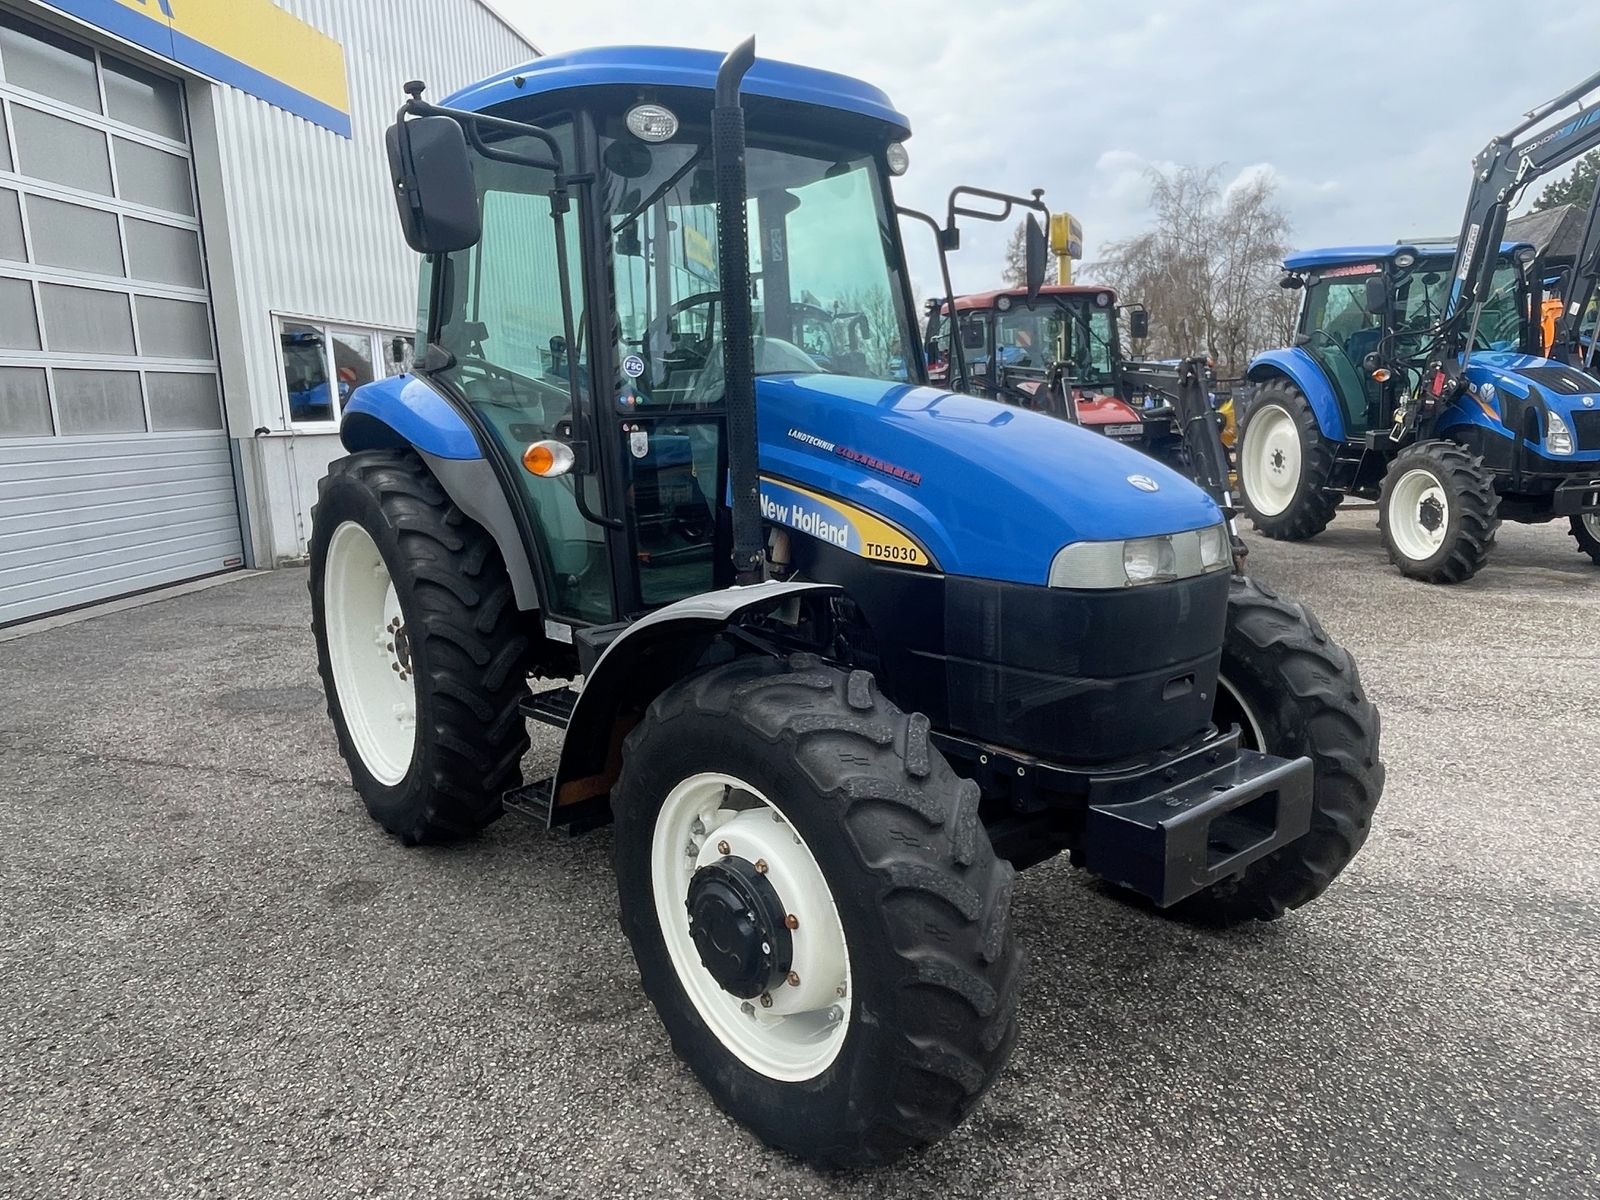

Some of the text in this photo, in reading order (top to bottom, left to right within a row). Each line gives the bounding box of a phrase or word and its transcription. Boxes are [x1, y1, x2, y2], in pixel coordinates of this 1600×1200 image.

[788, 428, 835, 452] LANDTECHNIK
[760, 493, 848, 548] New Holland
[866, 543, 918, 562] TD5030
